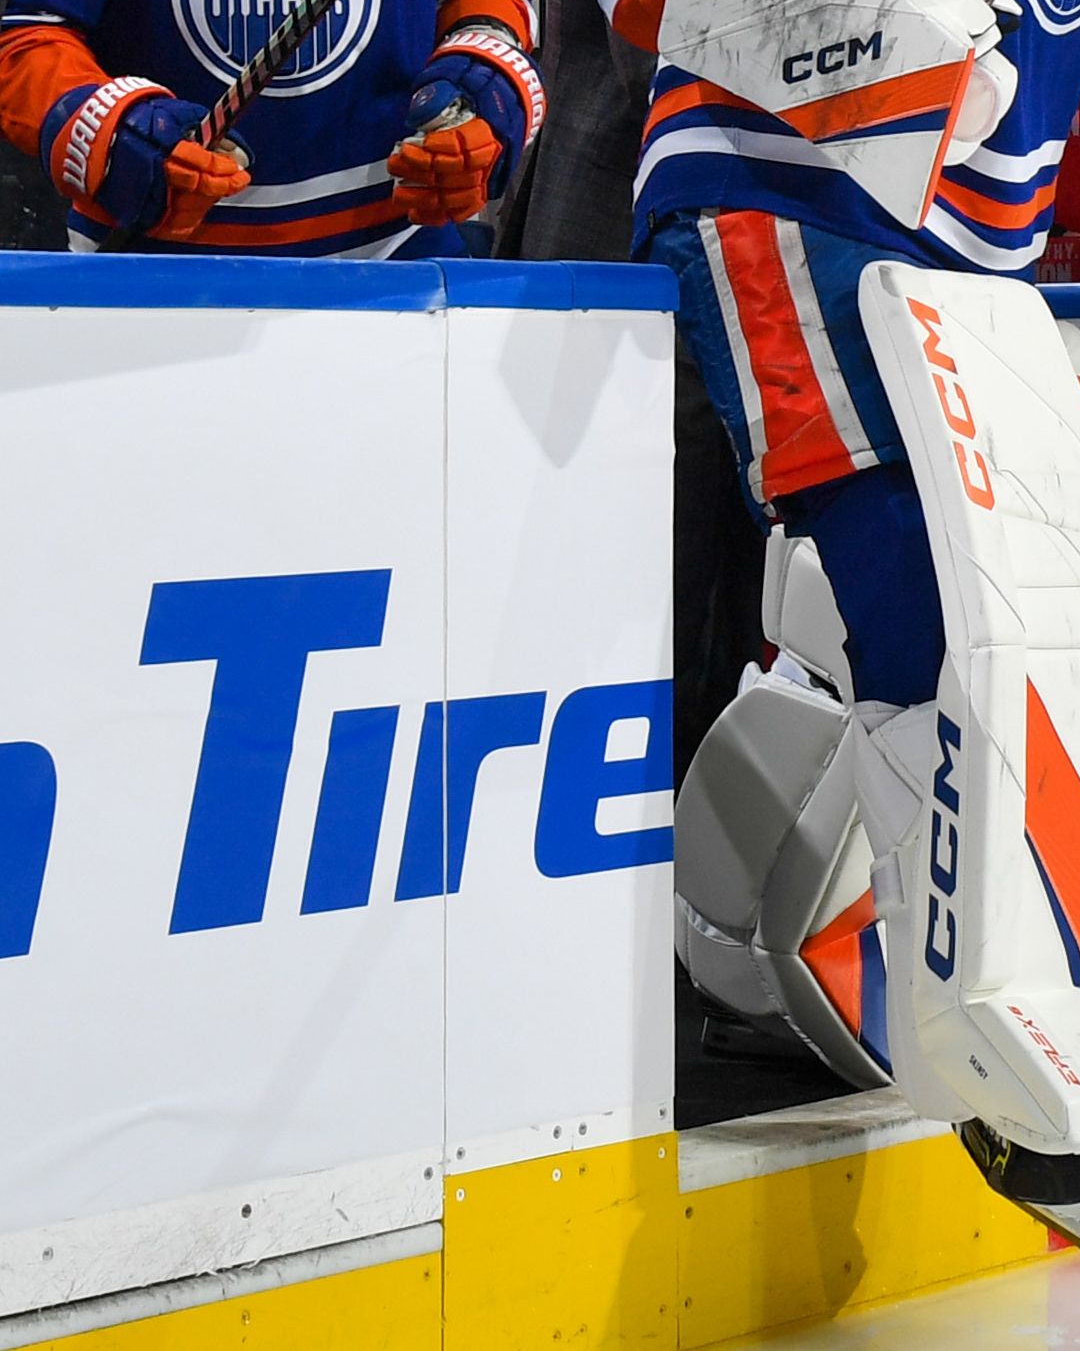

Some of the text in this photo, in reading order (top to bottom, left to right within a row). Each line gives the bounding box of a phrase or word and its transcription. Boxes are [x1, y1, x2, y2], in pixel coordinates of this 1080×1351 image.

[781, 30, 883, 85] CCM
[907, 296, 995, 512] CCM
[138, 567, 675, 936] Tire
[925, 709, 962, 983] CCM
